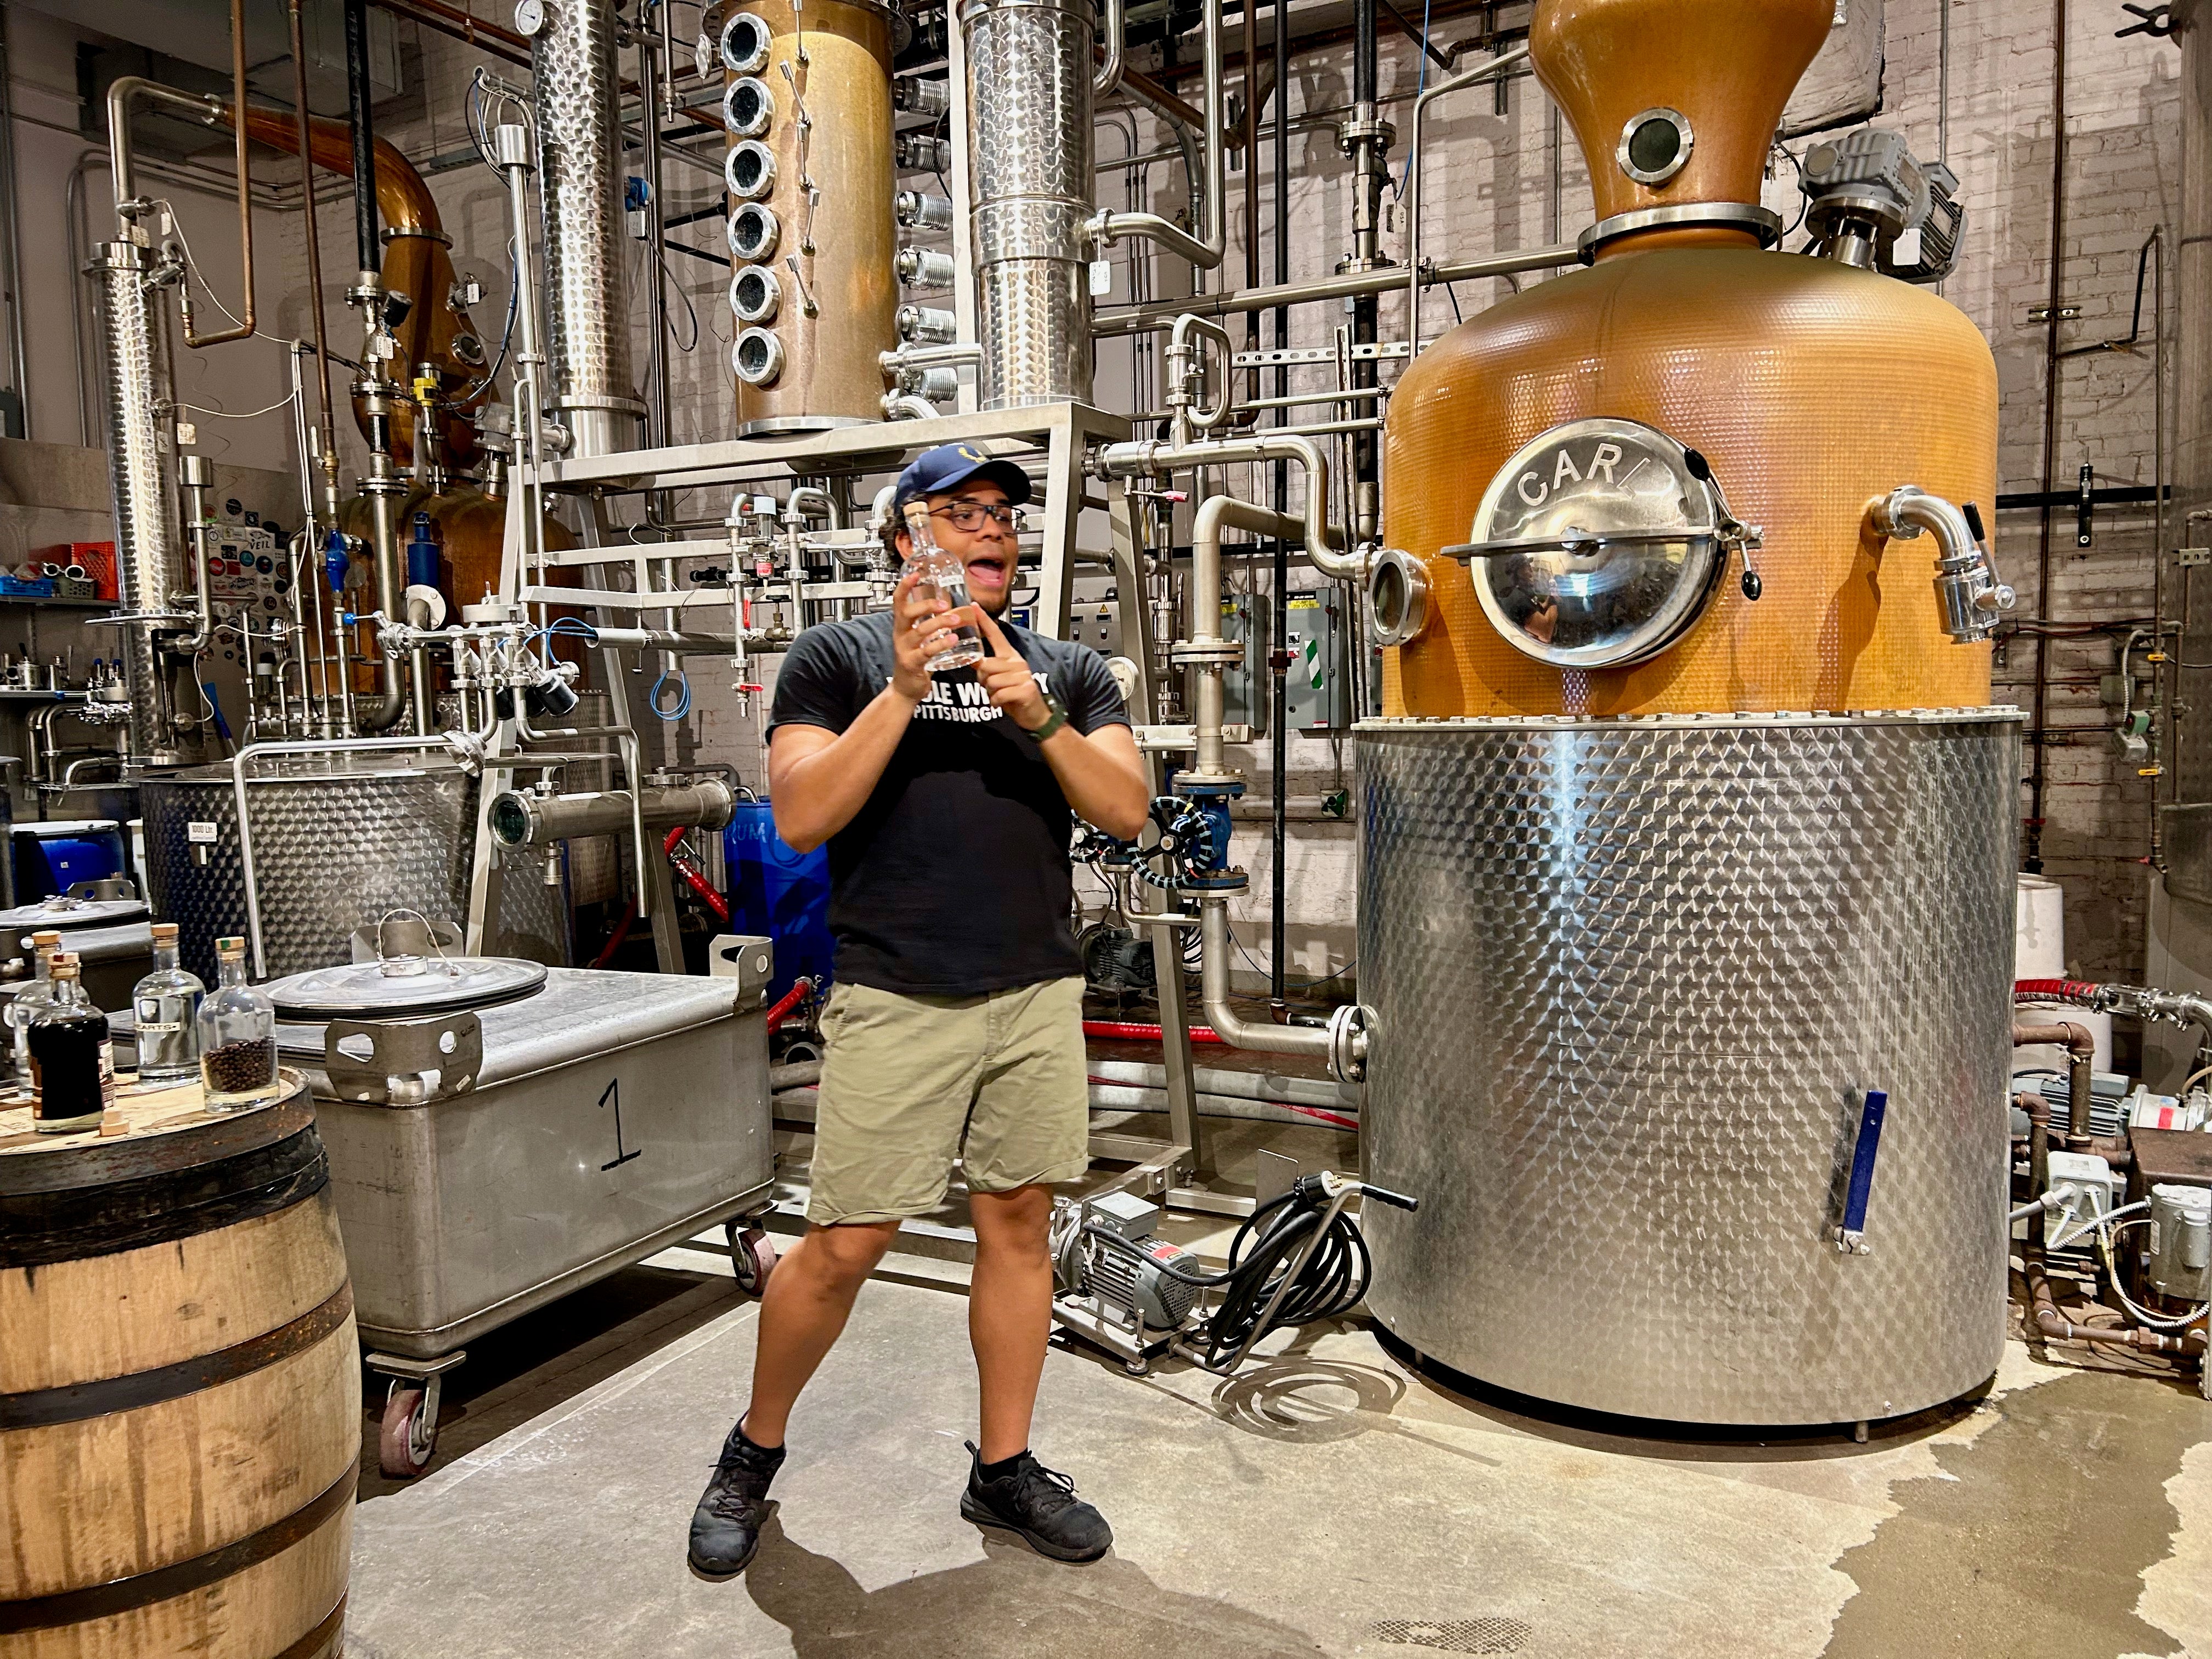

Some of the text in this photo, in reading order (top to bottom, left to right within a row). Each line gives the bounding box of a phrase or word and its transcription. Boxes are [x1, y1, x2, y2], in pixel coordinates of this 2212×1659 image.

[1517, 443, 1651, 506] CARL
[250, 540, 270, 550] VEIL
[913, 704, 1003, 723] PITTSBURGH
[598, 1077, 642, 1172] 1
